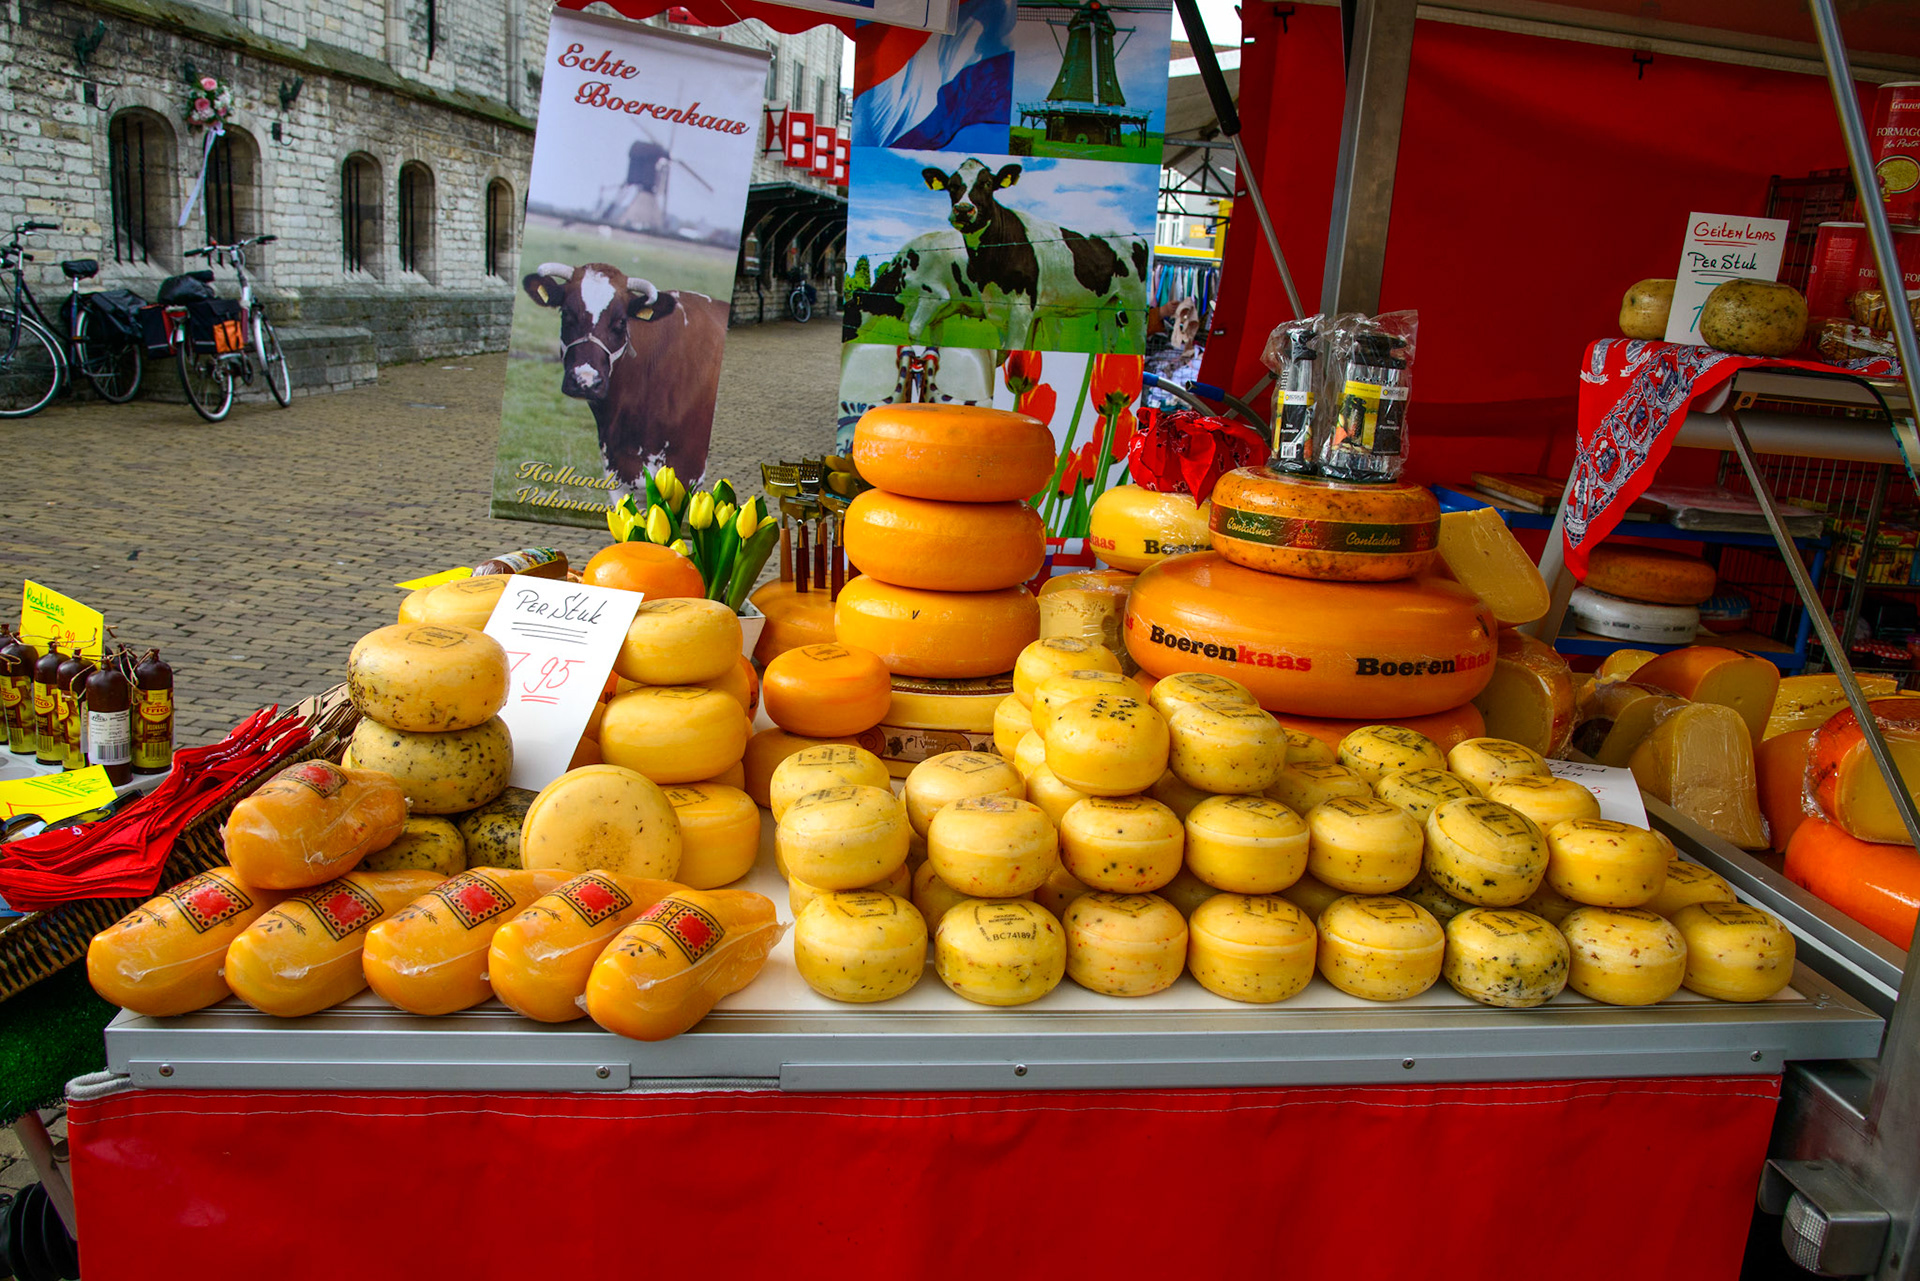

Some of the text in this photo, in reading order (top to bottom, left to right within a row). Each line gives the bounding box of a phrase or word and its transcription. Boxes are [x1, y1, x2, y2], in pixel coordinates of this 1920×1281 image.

[557, 42, 640, 80] Echte
[574, 81, 750, 136] Boerenkaas
[515, 460, 624, 491] Hollands
[1226, 517, 1272, 538] Contadino
[1345, 531, 1402, 547] Contadino
[1149, 624, 1312, 672] Boerenkaas
[1355, 651, 1490, 677] Boerenkaas
